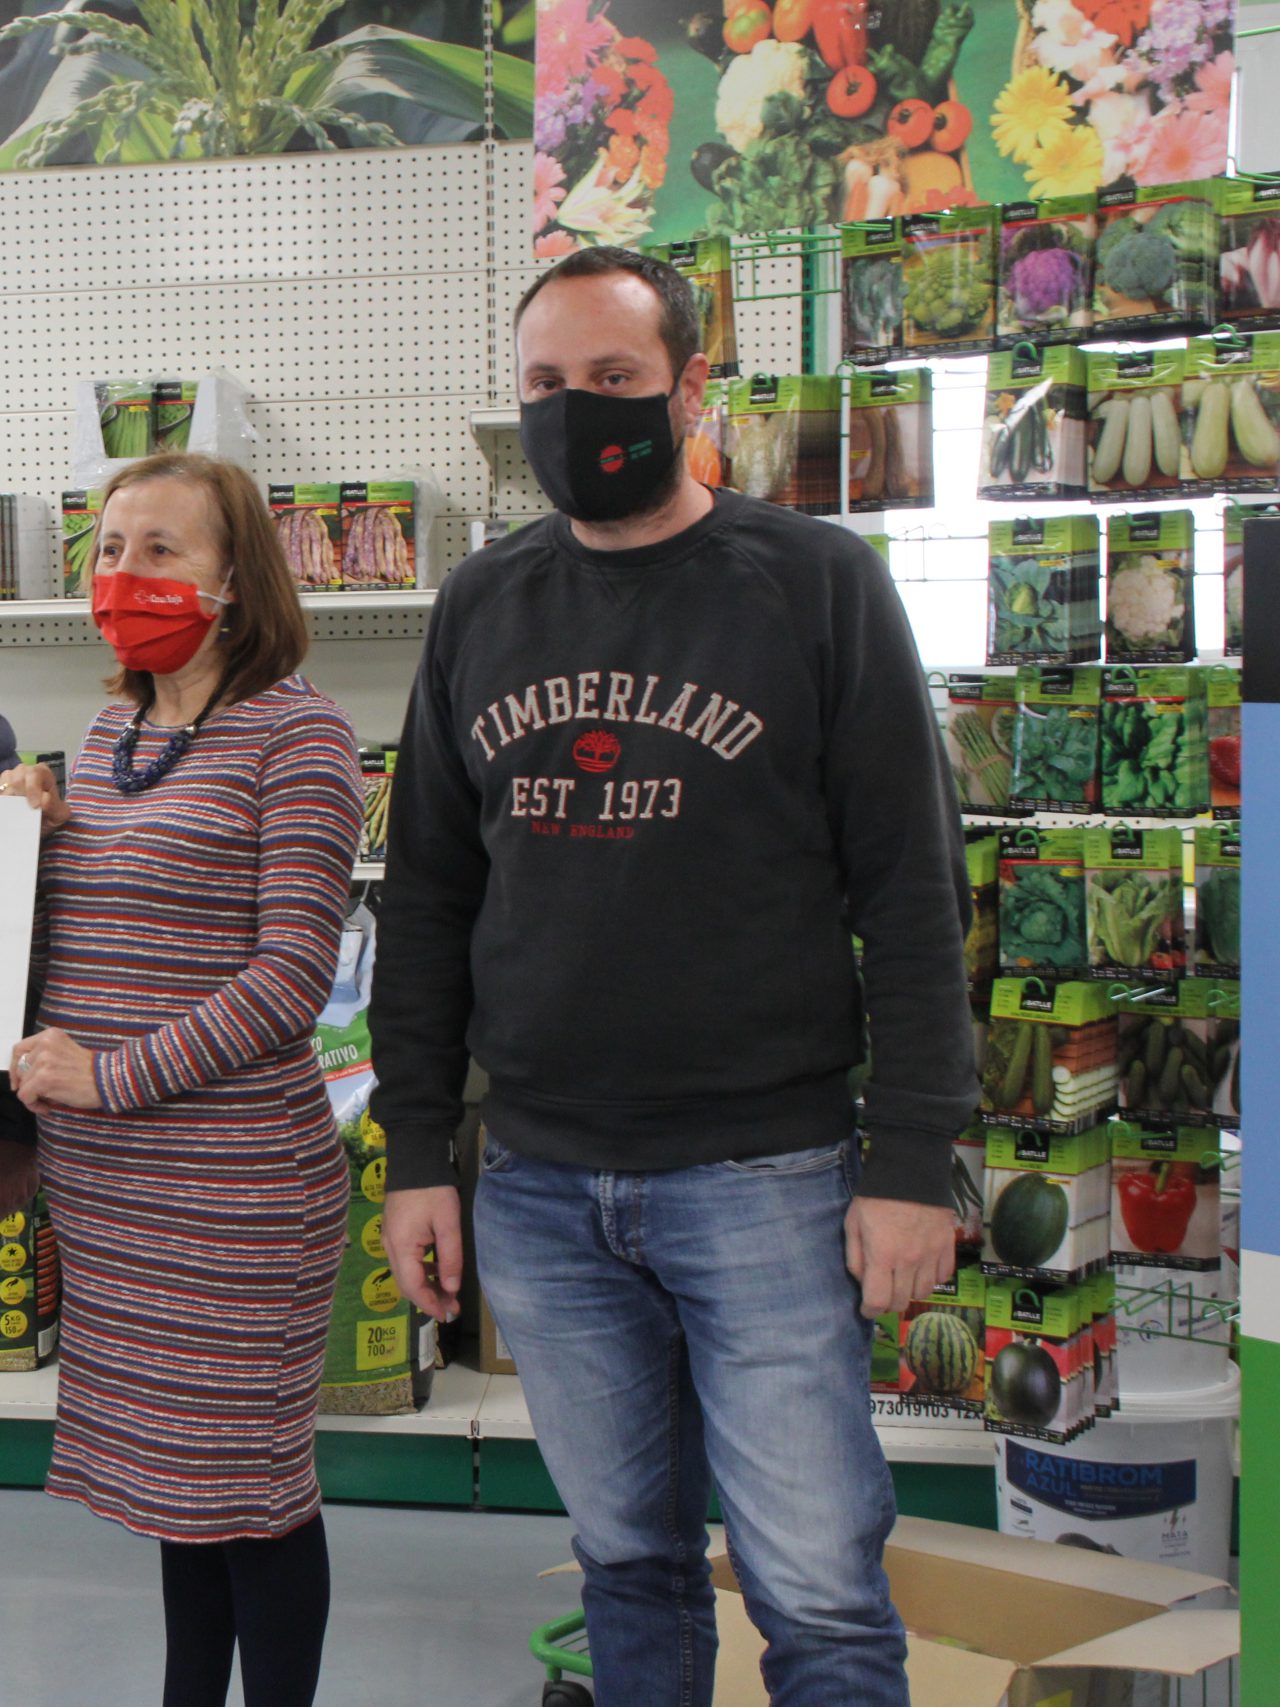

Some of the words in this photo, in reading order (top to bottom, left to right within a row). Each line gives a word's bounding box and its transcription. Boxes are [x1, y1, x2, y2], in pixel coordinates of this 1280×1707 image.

[471, 671, 764, 762] TIMBERLAND
[511, 777, 575, 818] EST
[598, 778, 683, 820] 1973
[531, 820, 560, 836] NEW
[570, 823, 635, 840] ENGLAND
[4, 1314, 10, 1326] 5
[367, 1326, 382, 1344] 20
[382, 1326, 396, 1336] KG
[367, 1343, 386, 1357] 700
[1024, 1450, 1164, 1487] RATIBROM
[1025, 1473, 1077, 1497] AZUL
